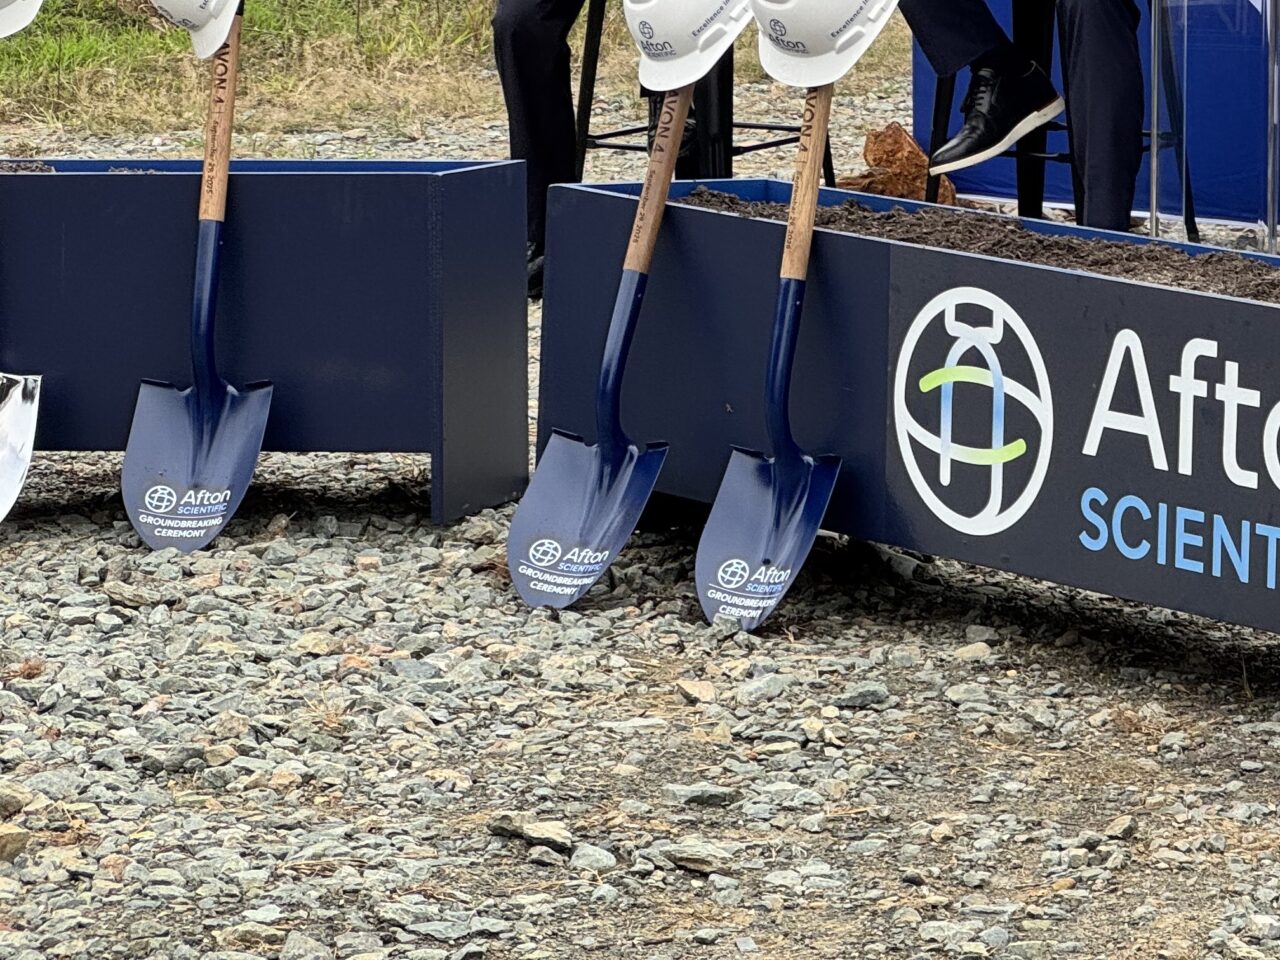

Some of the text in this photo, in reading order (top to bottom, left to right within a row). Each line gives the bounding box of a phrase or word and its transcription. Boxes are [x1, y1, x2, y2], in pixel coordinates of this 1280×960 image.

[692, 5, 724, 37] Excellence
[830, 5, 863, 38] Excellence
[641, 40, 672, 52] Afton
[180, 489, 231, 505] Afton
[177, 503, 227, 515] SCIENTIFIC
[139, 514, 222, 528] GROUNDBREAKING
[154, 528, 206, 538] CEREMONY
[563, 548, 610, 564] Afton
[518, 565, 594, 585] GROUNDBREAKING
[750, 566, 791, 583] Afton
[530, 581, 578, 595] CEREMONY
[719, 605, 763, 618] CEREMONY
